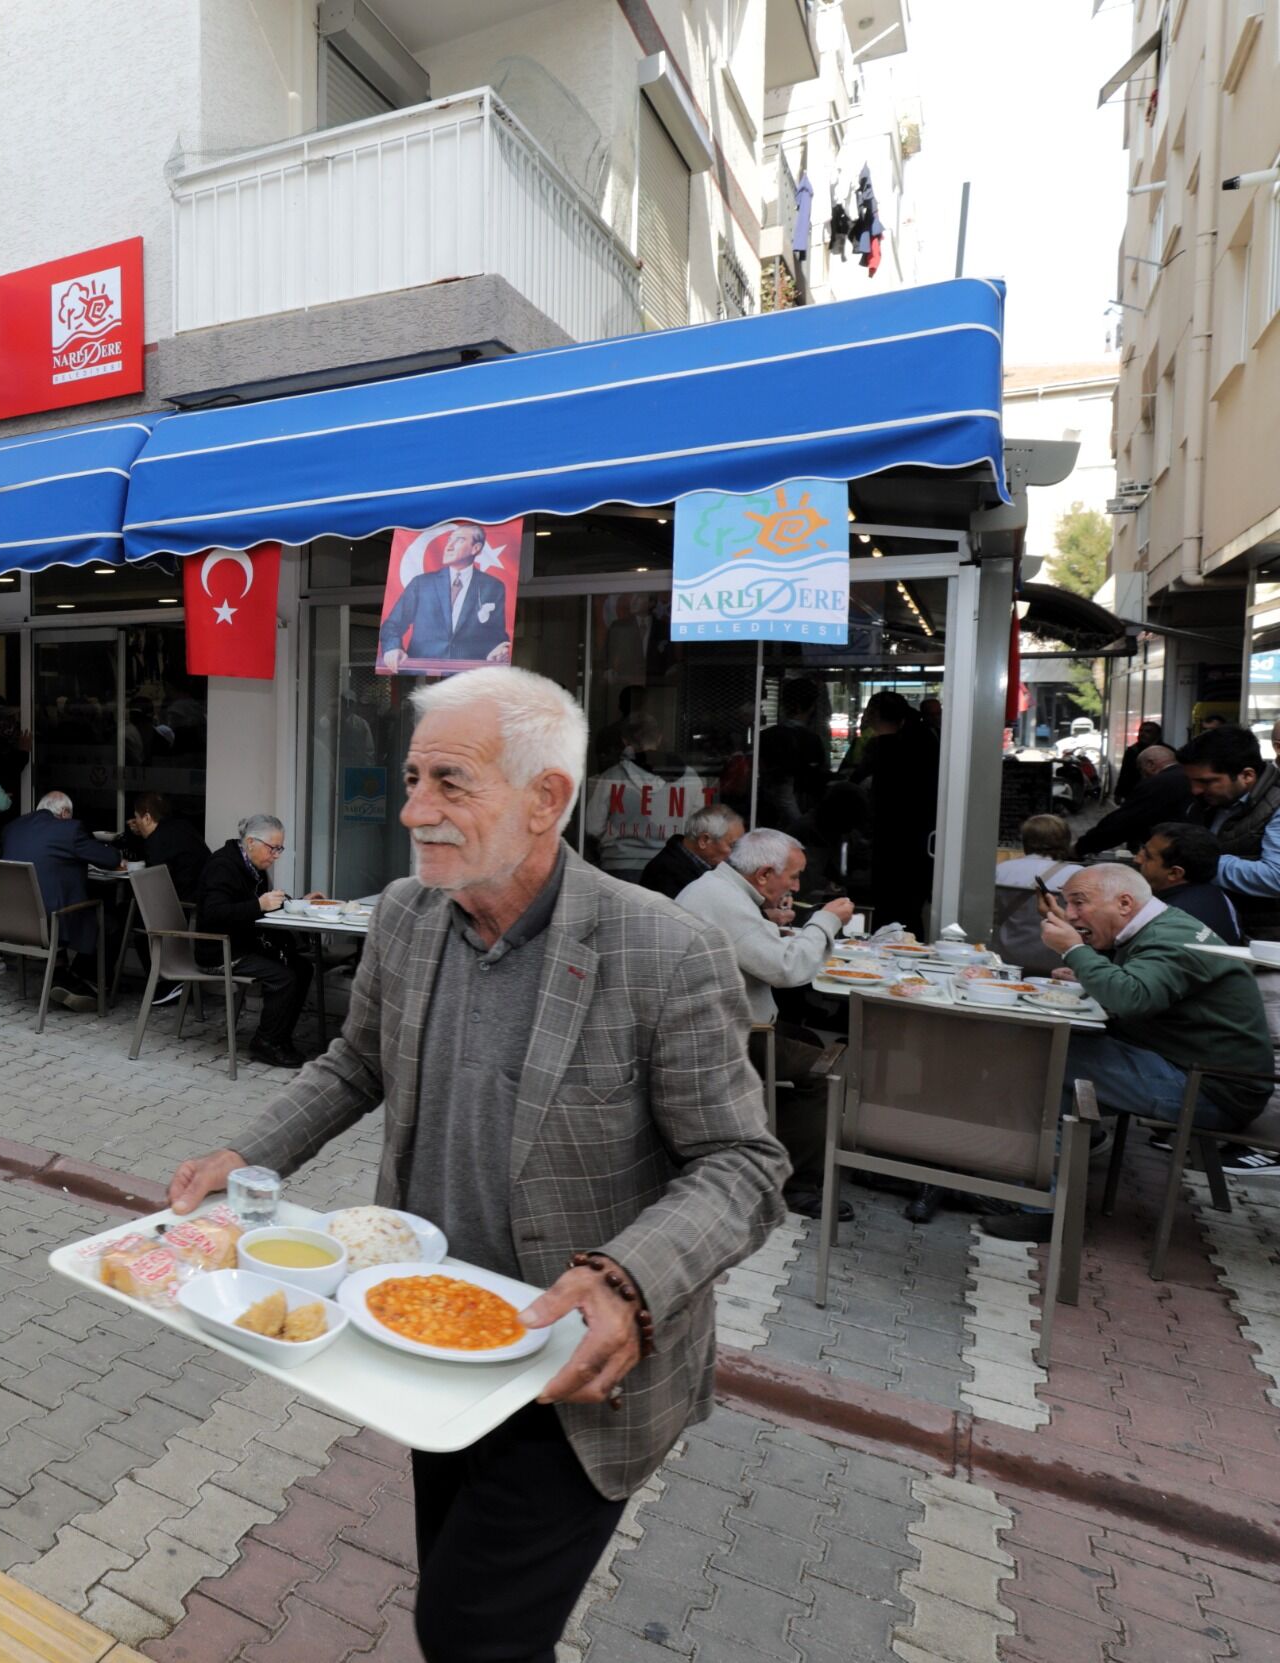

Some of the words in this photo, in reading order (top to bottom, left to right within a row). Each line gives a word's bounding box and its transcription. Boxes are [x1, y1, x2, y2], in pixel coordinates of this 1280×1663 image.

[677, 577, 846, 620] NARLIDERE
[679, 622, 841, 637] BELEDİYESİ
[610, 784, 717, 818] KENT
